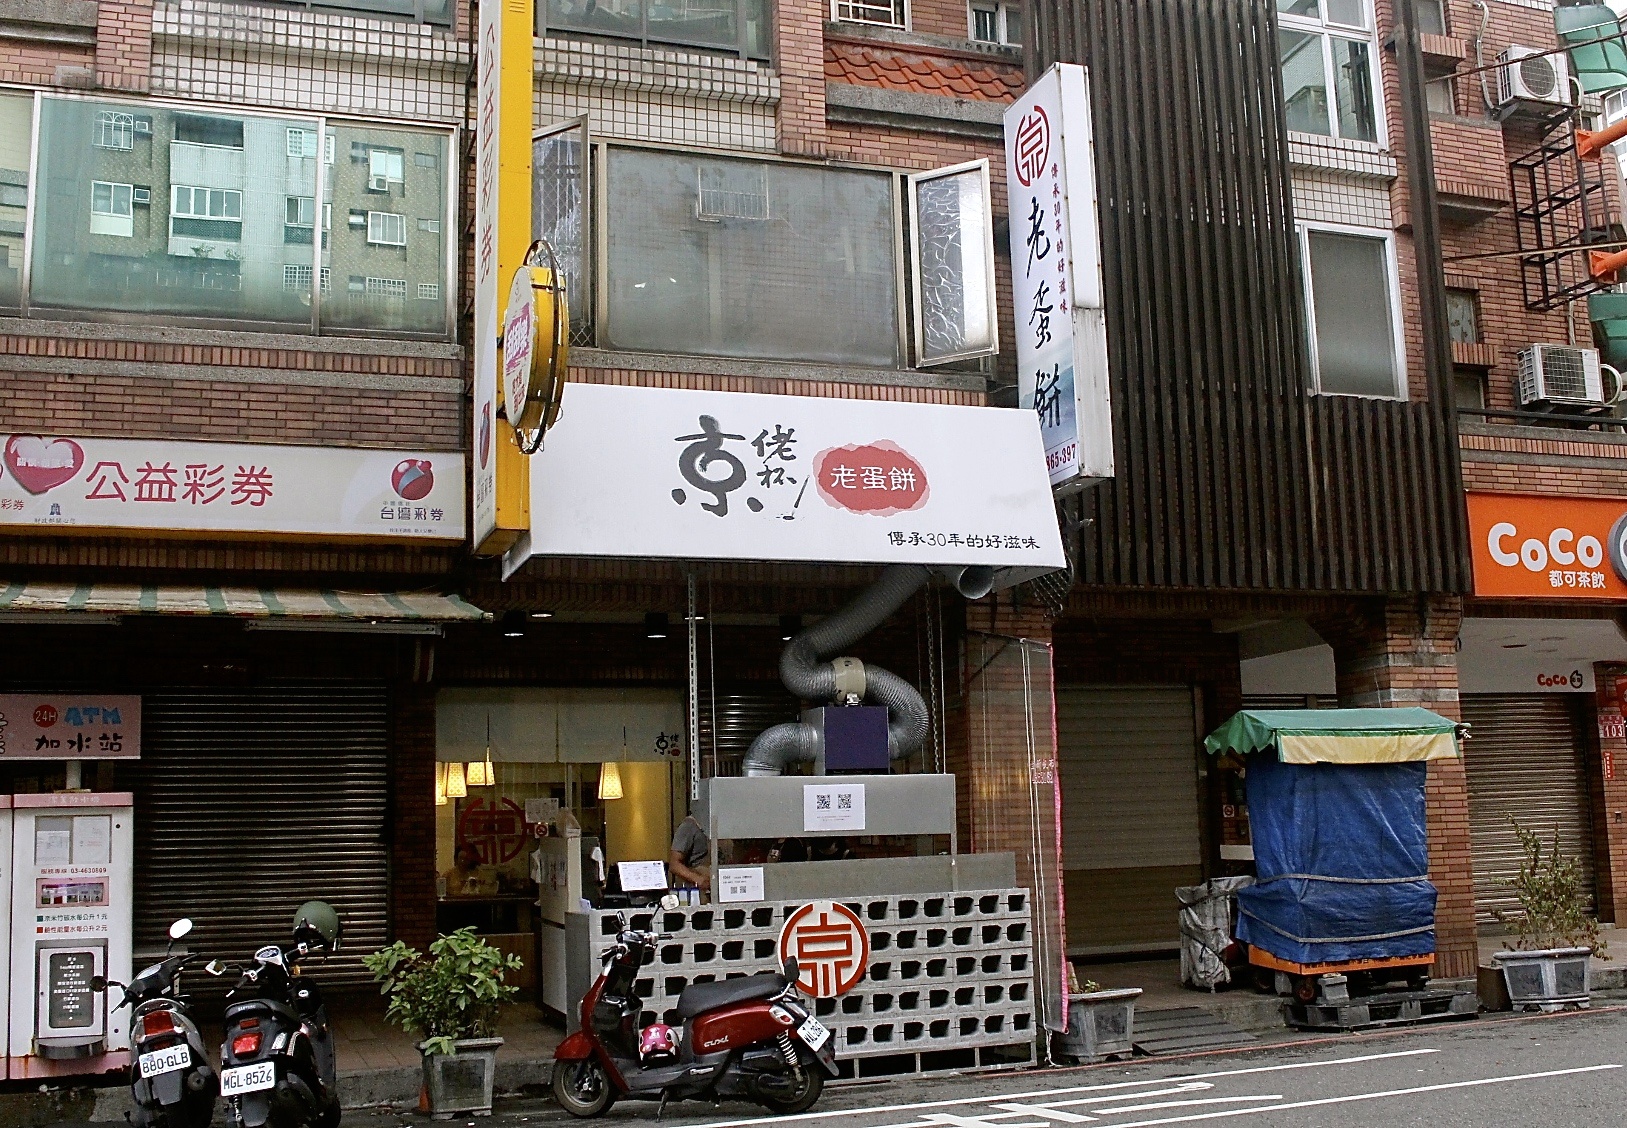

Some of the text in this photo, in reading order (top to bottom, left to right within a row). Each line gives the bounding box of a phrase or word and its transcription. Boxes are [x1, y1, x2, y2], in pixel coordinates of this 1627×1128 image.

[481, 22, 494, 285] 公益彩券
[1026, 196, 1062, 429] 老蛋餅
[85, 461, 273, 507] 公益彩券
[830, 464, 917, 492] 老蛋餅
[380, 506, 444, 521] 台灣彩券
[887, 531, 1041, 550] 傳承30年的好滋味
[1487, 522, 1603, 572] CoCo
[1548, 570, 1606, 589] 都可茶飲
[1537, 673, 1568, 687] CoCo
[35, 706, 122, 726] 24H ATM
[1605, 725, 1623, 737] 103
[35, 732, 123, 753] 加水站
[142, 1051, 189, 1074] 880-GLB
[223, 1068, 273, 1090] MGL-8526
